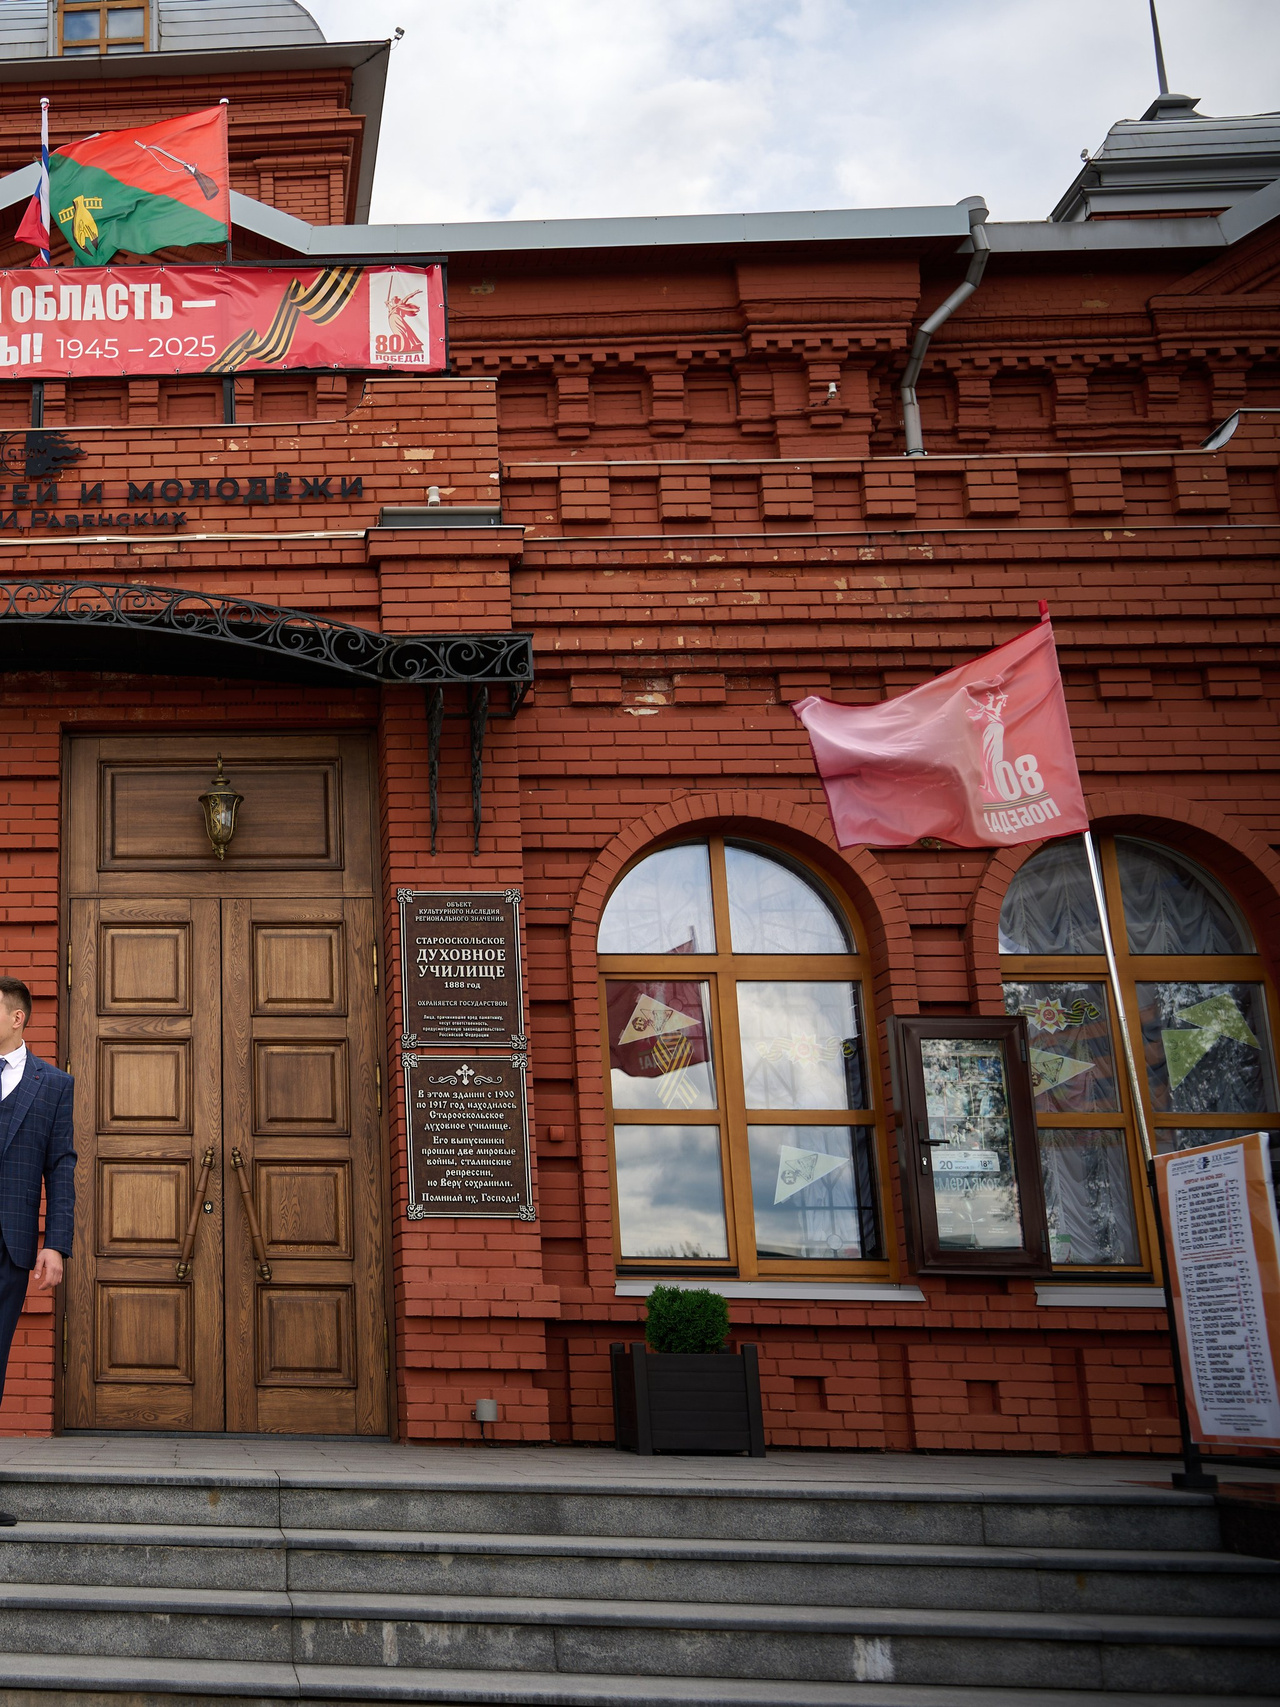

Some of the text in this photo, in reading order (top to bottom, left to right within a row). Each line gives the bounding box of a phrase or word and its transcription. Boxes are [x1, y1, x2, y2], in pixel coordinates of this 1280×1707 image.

[11, 283, 173, 321] ОБЛАСТЬ
[56, 338, 119, 359] 1945
[148, 335, 216, 358] 2025
[375, 334, 401, 353] 80
[375, 354, 425, 363] ПОБЕДА!
[81, 483, 103, 505] И
[127, 472, 363, 505] МОЛОДЁЖИ
[416, 937, 505, 945] СТАРООСКОЛЬСКОЕ
[416, 949, 506, 963] ДУХОВНОЕ
[418, 965, 506, 979] УЧИЛИЩЕ
[417, 1090, 425, 1098] В
[452, 1091, 485, 1099] здании
[494, 1090, 515, 1098] 1900
[428, 1101, 447, 1109] 1917
[449, 1102, 465, 1110] год
[467, 1102, 517, 1110] находилось
[429, 1111, 504, 1120] Старооскольское
[424, 1123, 511, 1131] духовное училище.
[432, 1136, 505, 1146] Его выпускники
[421, 1148, 517, 1156] прошли две мировые
[426, 1157, 512, 1167] войны, сталинские
[939, 1160, 953, 1170] 20
[445, 1169, 494, 1178] репрессии,
[440, 1178, 462, 1189] Веру
[464, 1180, 513, 1189] сохранили.
[422, 1193, 520, 1204] Поминай их, Господи!
